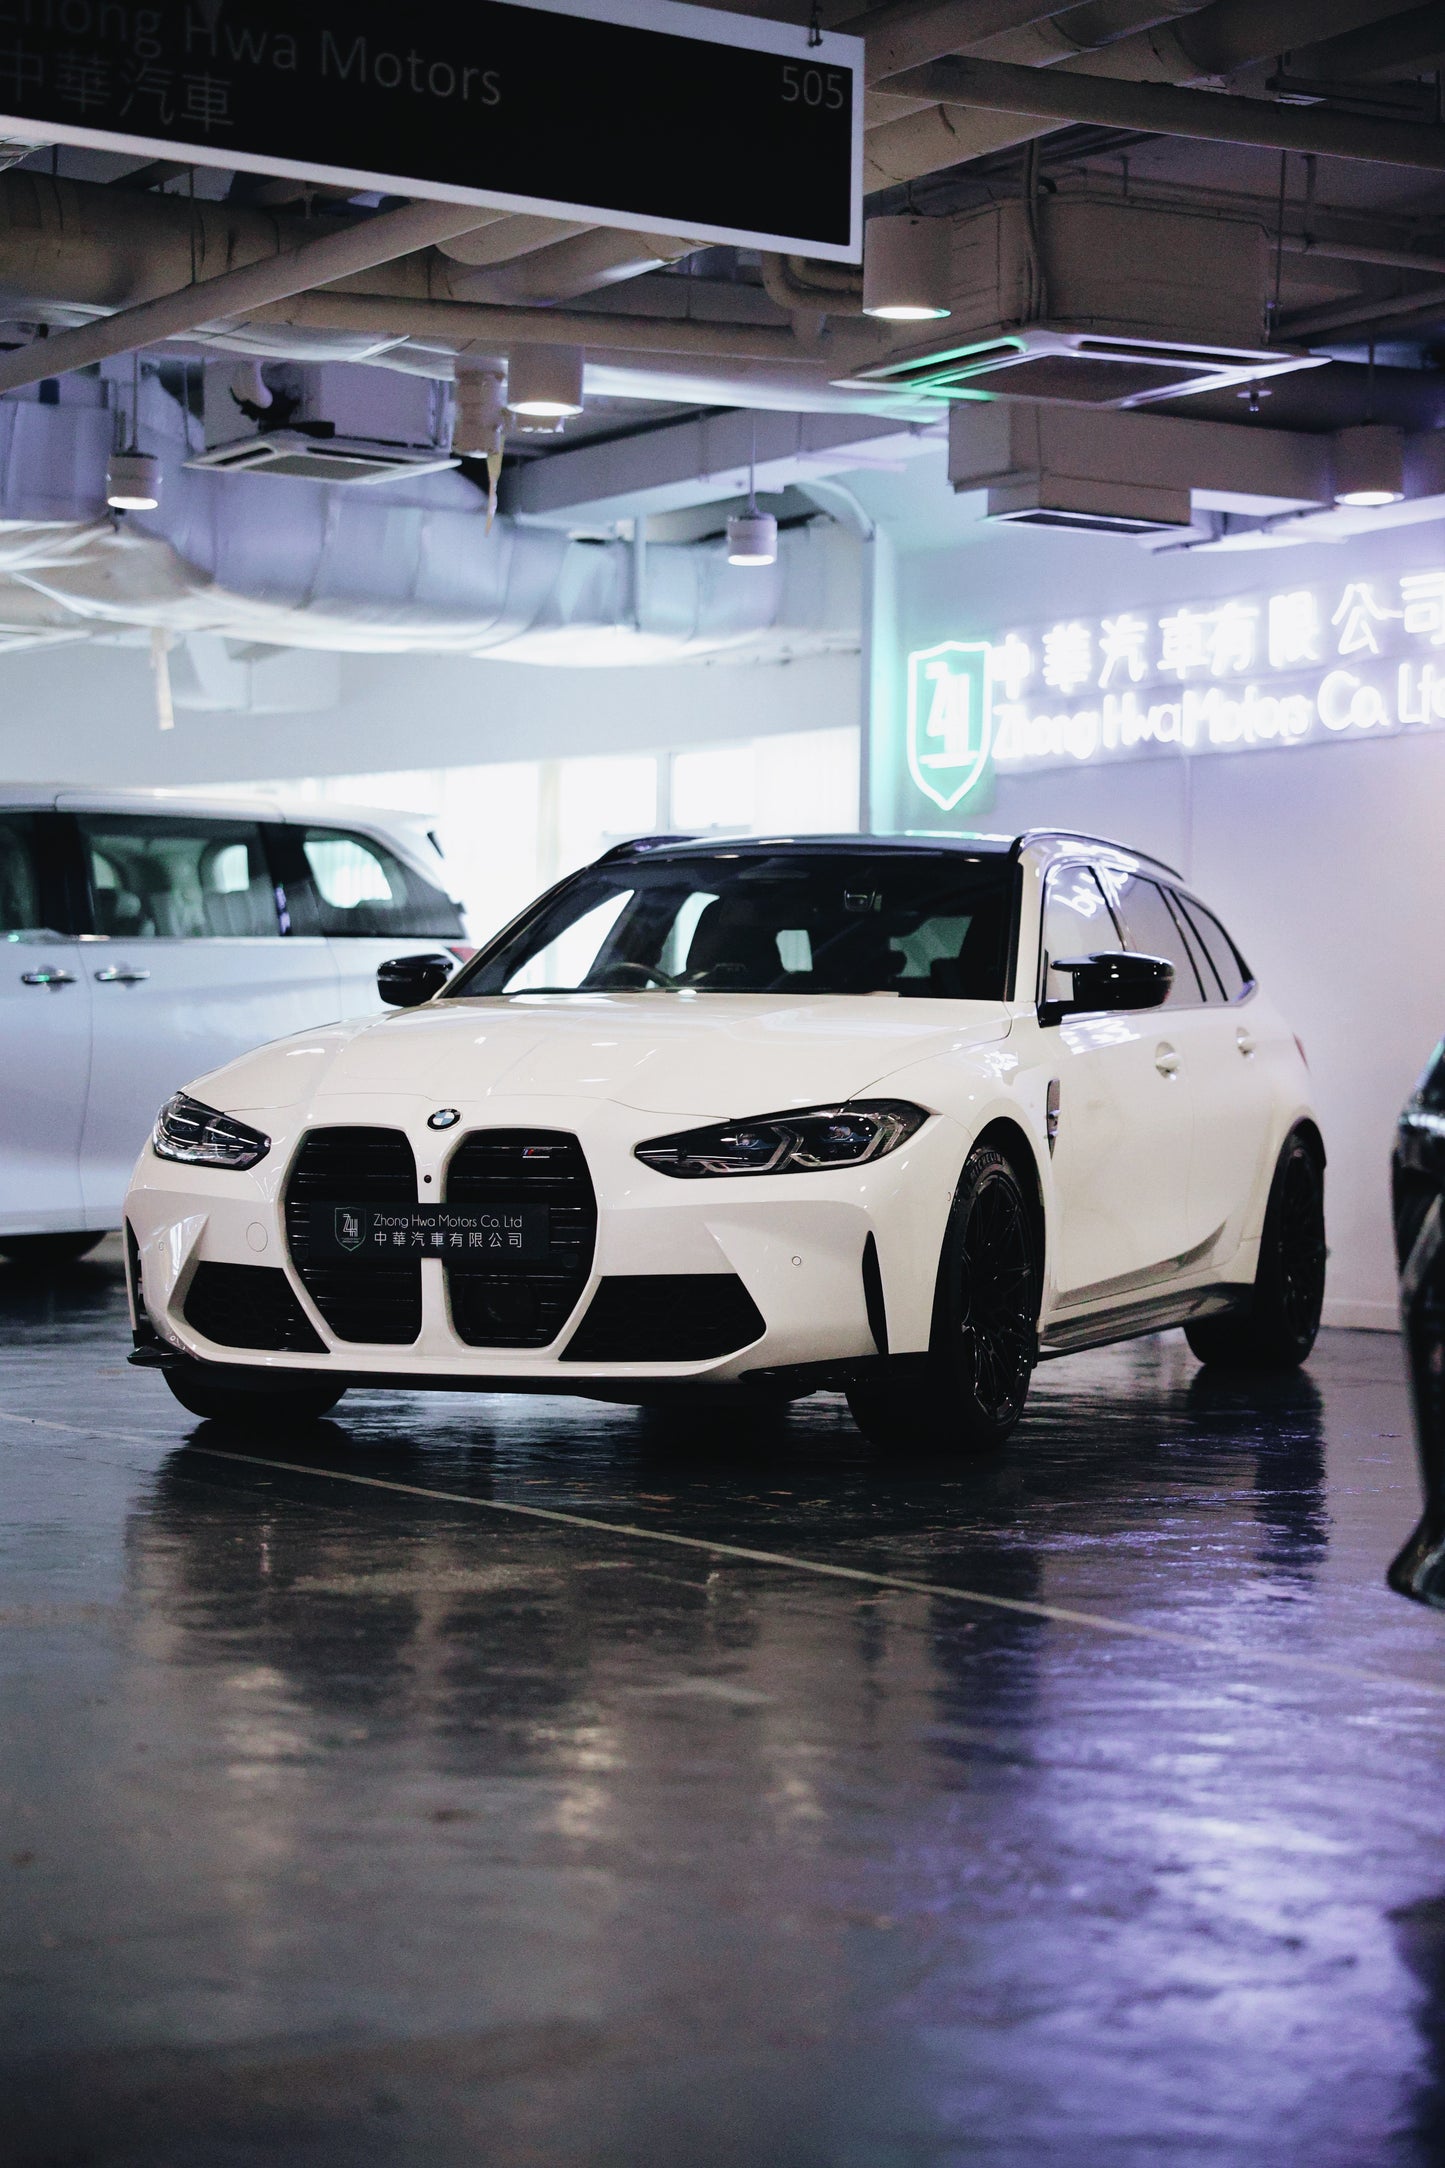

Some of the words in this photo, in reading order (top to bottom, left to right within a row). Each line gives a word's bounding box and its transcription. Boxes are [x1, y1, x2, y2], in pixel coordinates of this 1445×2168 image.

[0, 0, 162, 59] ong
[184, 3, 298, 71] Hwa
[321, 29, 501, 106] Motors
[0, 39, 235, 133] 中華汽車
[781, 65, 844, 109] 505
[373, 1213, 409, 1229] Zhong
[411, 1214, 436, 1228] Hwa
[438, 1214, 477, 1228] Motors
[503, 1215, 523, 1228] Ltd
[374, 1231, 523, 1248] 中華汽車有限公司
